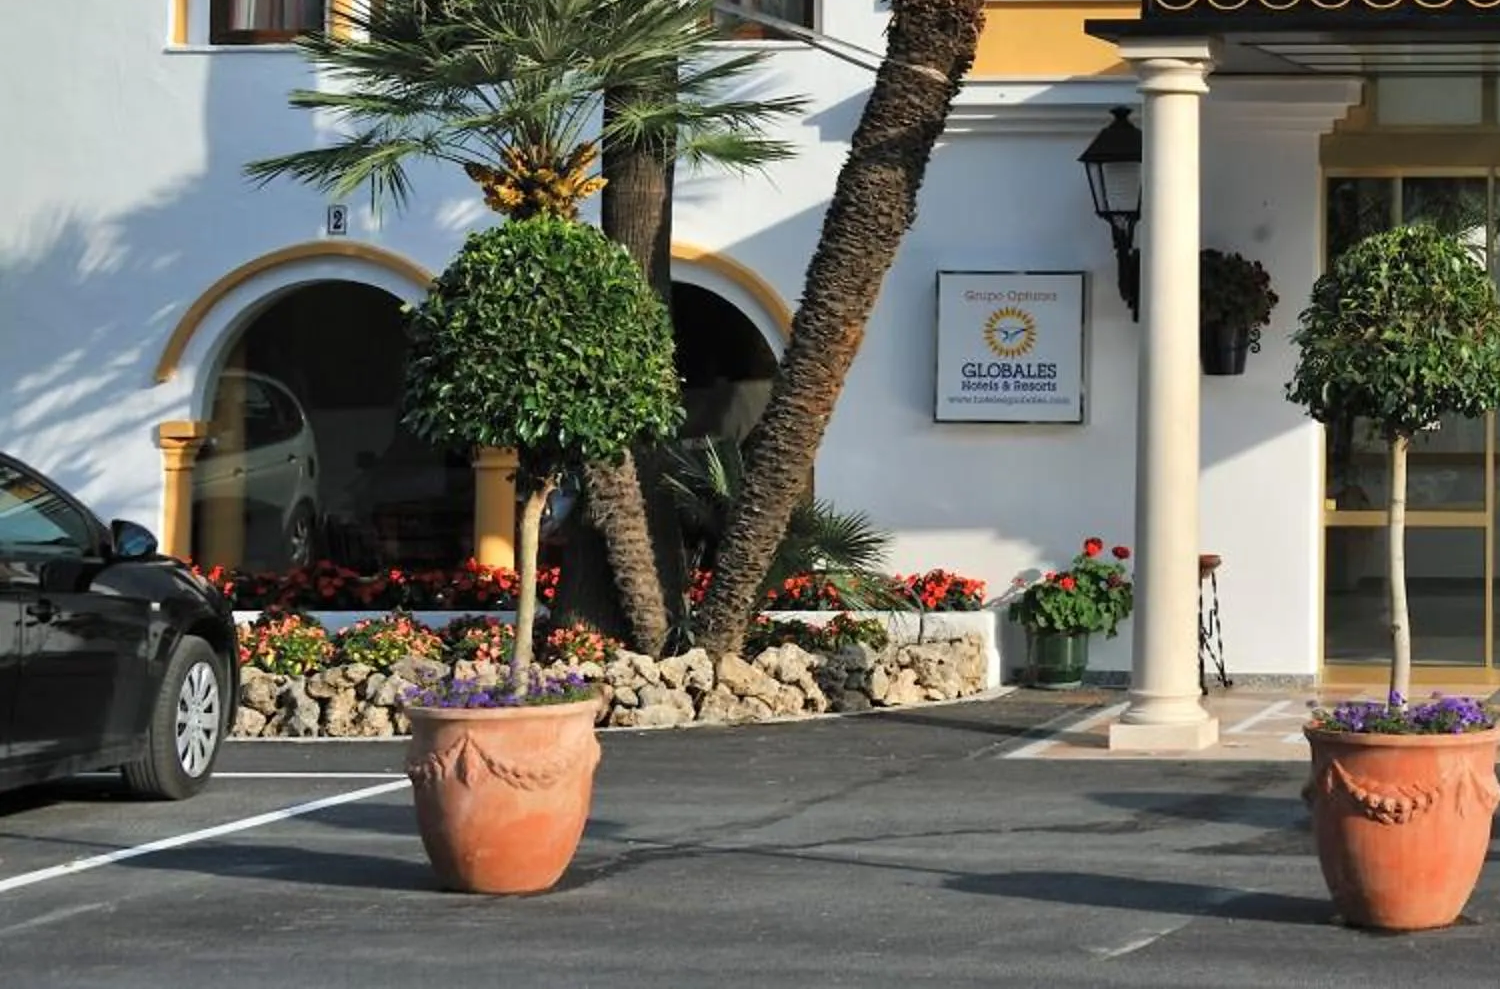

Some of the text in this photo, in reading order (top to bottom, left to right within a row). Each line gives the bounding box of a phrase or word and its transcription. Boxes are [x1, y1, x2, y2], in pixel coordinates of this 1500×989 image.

[333, 210, 343, 230] 2
[961, 362, 1057, 379] GLOBALES
[961, 380, 1058, 392] Hotels & Resorts
